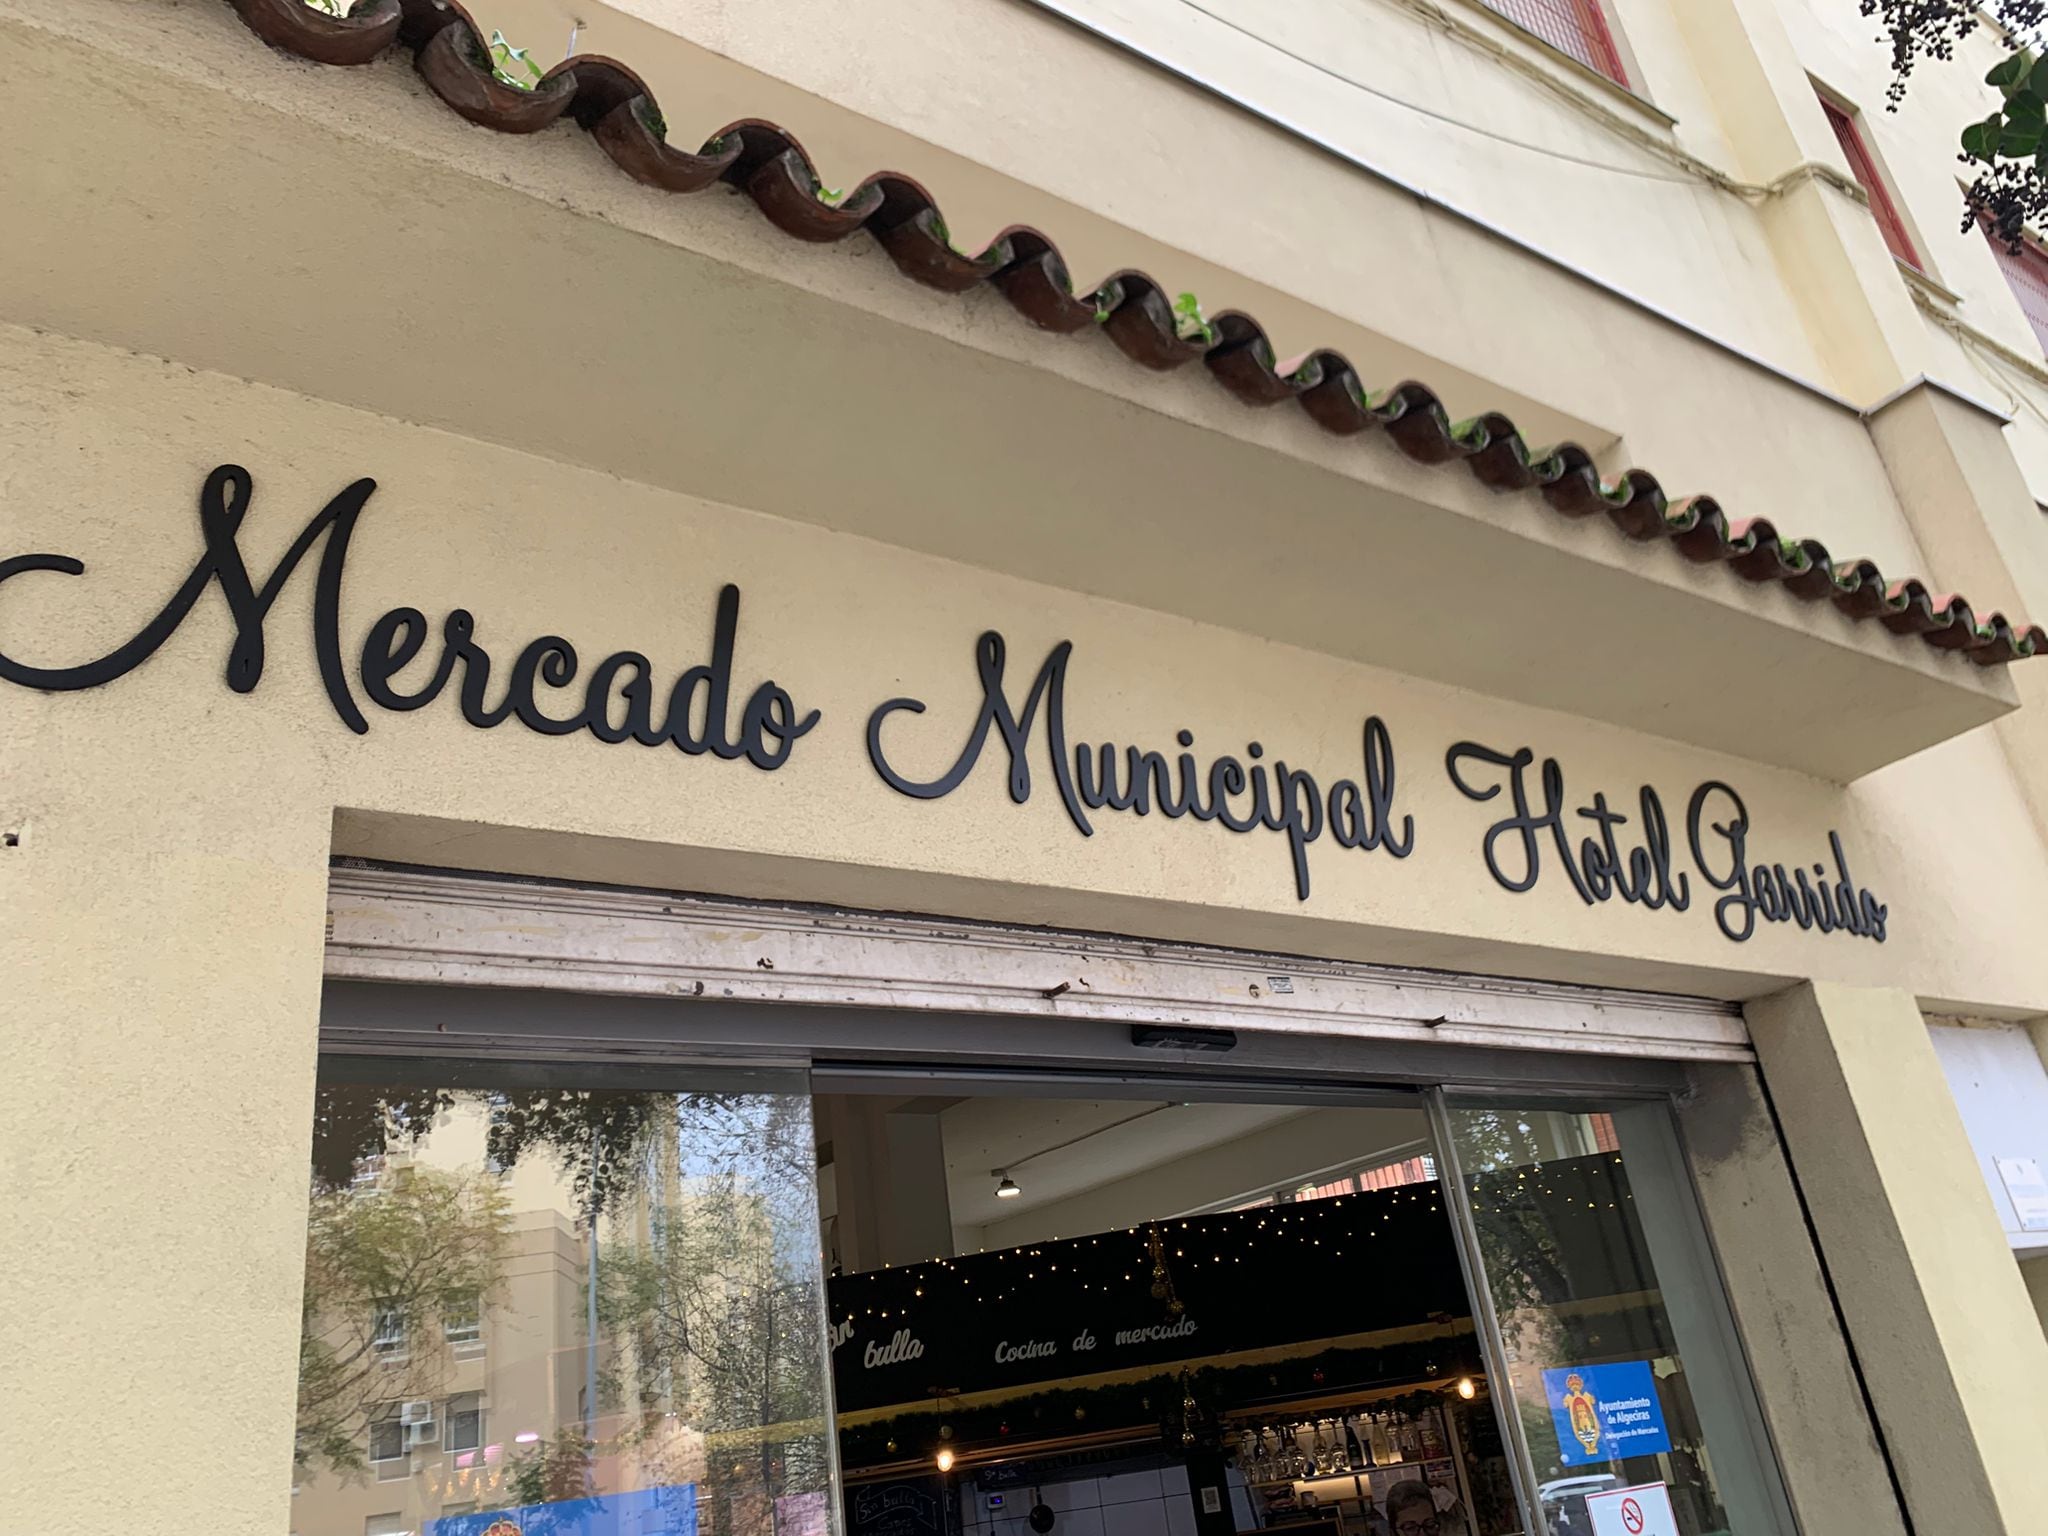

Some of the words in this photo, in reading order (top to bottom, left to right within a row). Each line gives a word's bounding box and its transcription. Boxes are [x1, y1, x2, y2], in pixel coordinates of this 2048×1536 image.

[0, 464, 821, 771] Mercado
[867, 630, 1414, 901] Municipal
[1446, 741, 1690, 911] Hotel
[1687, 781, 1888, 942] Garrido
[864, 1328, 924, 1369] bulla
[995, 1340, 1057, 1363] Cocina
[1072, 1328, 1097, 1351] de
[1115, 1314, 1199, 1346] mercado
[1599, 1397, 1651, 1414] Ayuntamiento
[1607, 1414, 1617, 1425] de
[1616, 1410, 1651, 1425] Algeciras
